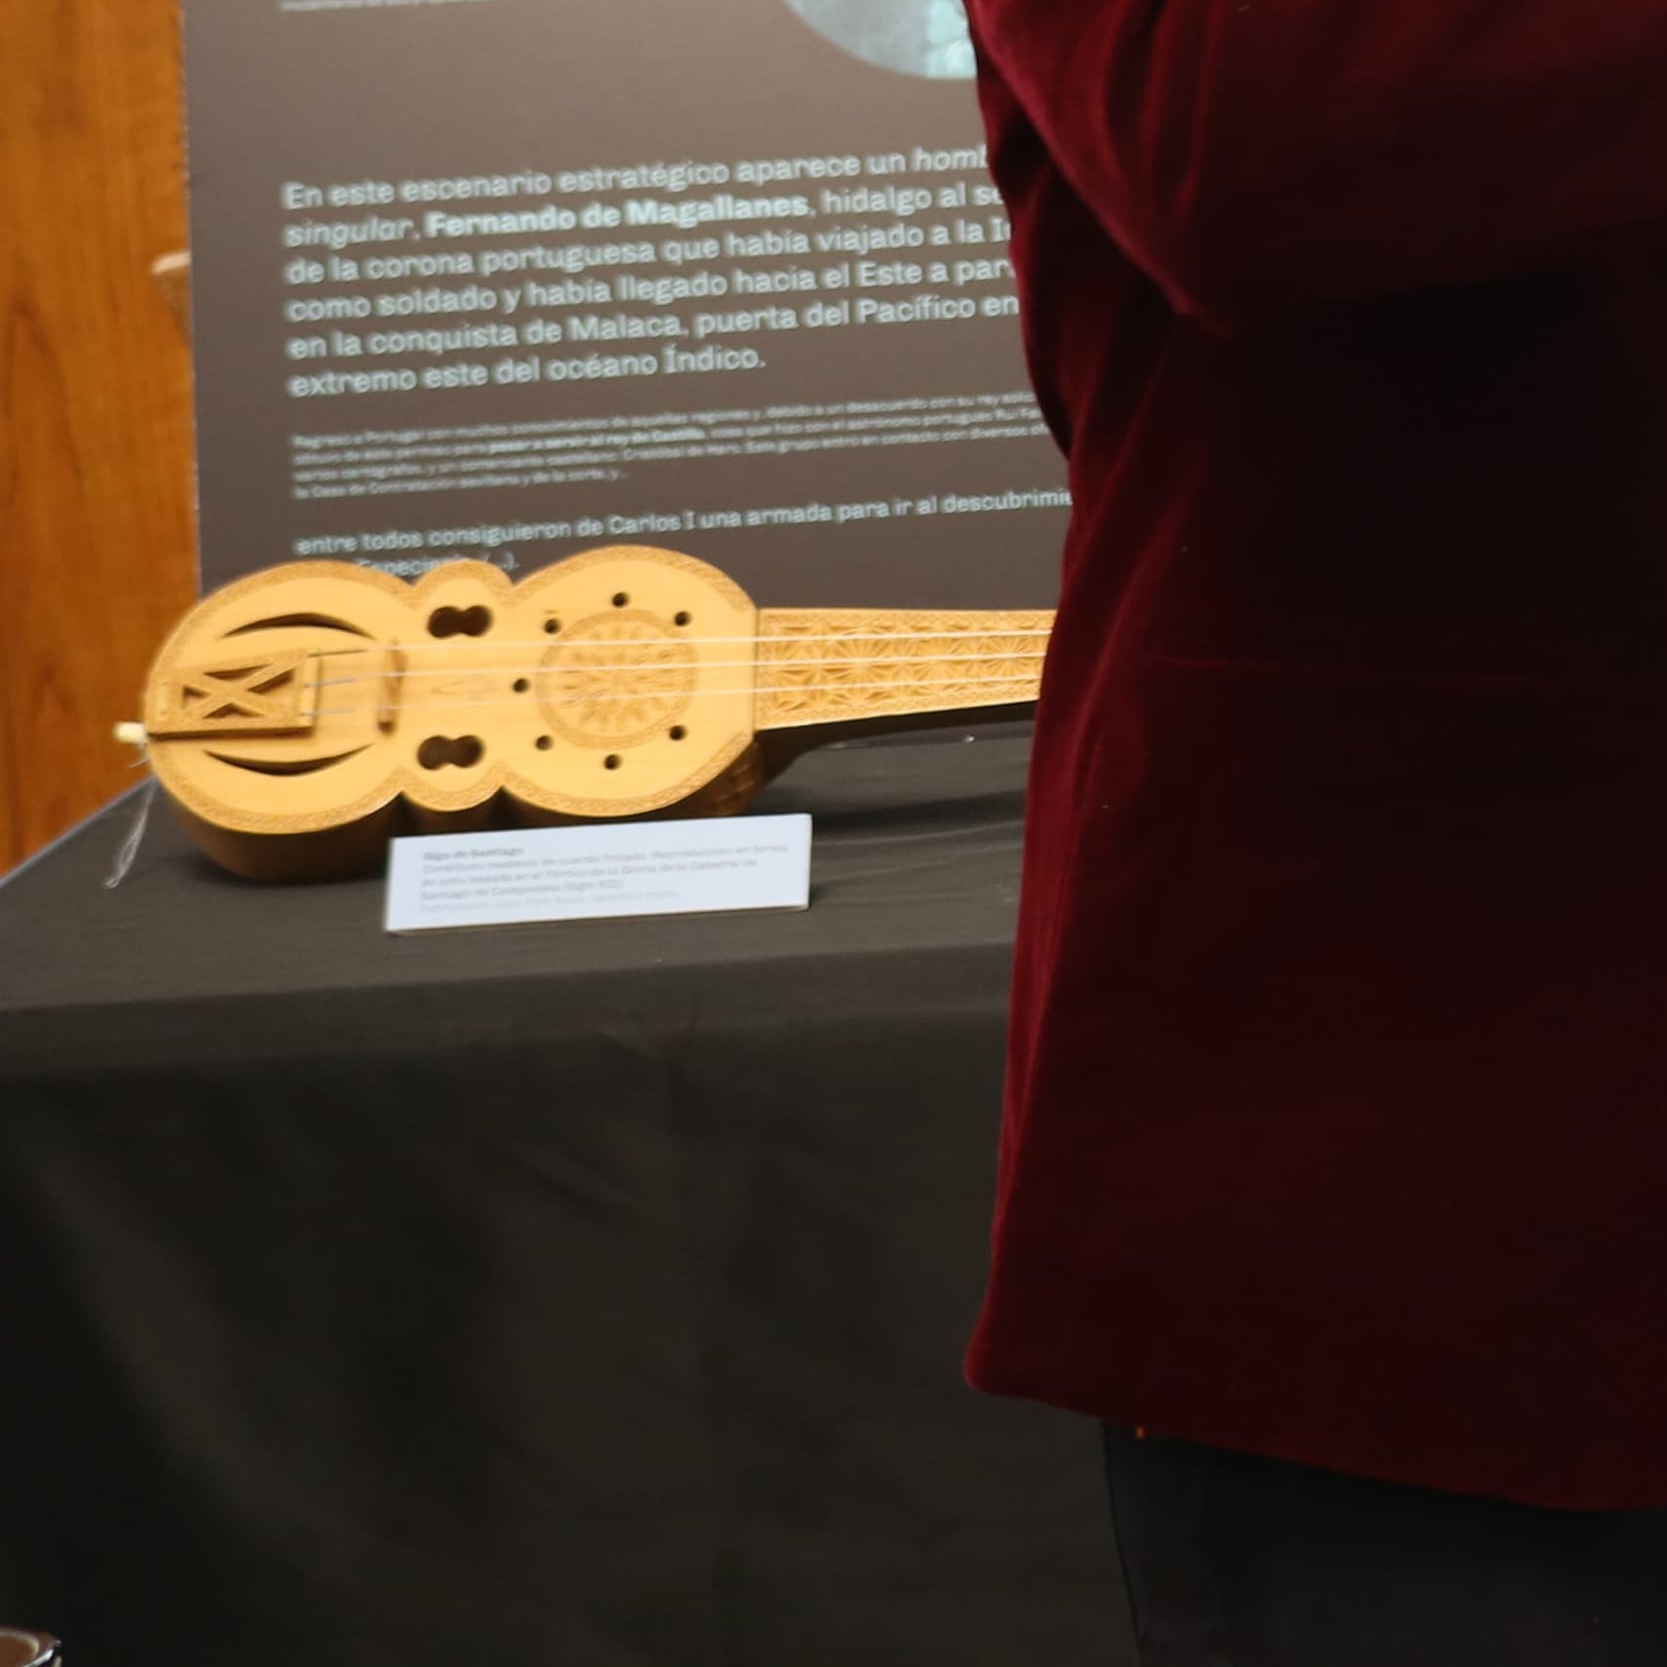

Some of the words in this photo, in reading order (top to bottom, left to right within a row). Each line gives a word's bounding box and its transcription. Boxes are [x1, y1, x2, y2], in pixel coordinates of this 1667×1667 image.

[285, 180, 321, 209] En
[332, 177, 393, 206] este
[402, 167, 550, 202] escenario
[559, 156, 729, 199] estratégico
[736, 155, 860, 189] aparece
[867, 152, 905, 174] un
[427, 202, 575, 238] Fernando
[582, 199, 620, 229] de
[625, 188, 816, 233] Magallanes,
[822, 181, 930, 221] hidalgo
[940, 179, 965, 207] al
[289, 255, 322, 284] de
[332, 253, 357, 281] la
[368, 253, 472, 279] corona
[481, 236, 654, 279] portuguesa
[663, 238, 718, 268] que
[725, 225, 808, 257] había
[817, 218, 923, 258] viajado
[931, 224, 948, 245] a
[956, 215, 983, 243] la
[290, 296, 369, 321] como
[379, 282, 495, 316] soldado
[504, 287, 518, 315] y
[527, 275, 610, 307] había
[617, 267, 726, 308] llegado
[733, 262, 815, 294] hacia
[823, 260, 849, 289] el
[856, 256, 921, 287] Este
[929, 261, 947, 282] a
[291, 337, 325, 359] en
[334, 327, 360, 356] la
[371, 319, 516, 360] conquista
[525, 315, 560, 344] de
[568, 308, 688, 346] Malaca,
[695, 302, 796, 341] puerta
[804, 298, 849, 327] del
[856, 290, 974, 324] Pacífico
[982, 294, 1018, 316] en
[292, 363, 415, 396] extremo
[424, 358, 486, 388] este
[496, 354, 539, 384] del
[548, 347, 656, 380] océano
[663, 342, 766, 373] Índico.
[298, 533, 356, 554] entre
[362, 528, 422, 550] todos
[429, 520, 570, 550] consiguieron
[577, 517, 603, 536] de
[608, 512, 680, 534] Carlos
[685, 511, 694, 529] I
[701, 512, 741, 528] una
[747, 502, 831, 525] armada
[836, 503, 888, 524] para
[894, 498, 907, 516] ir
[917, 495, 937, 514] al
